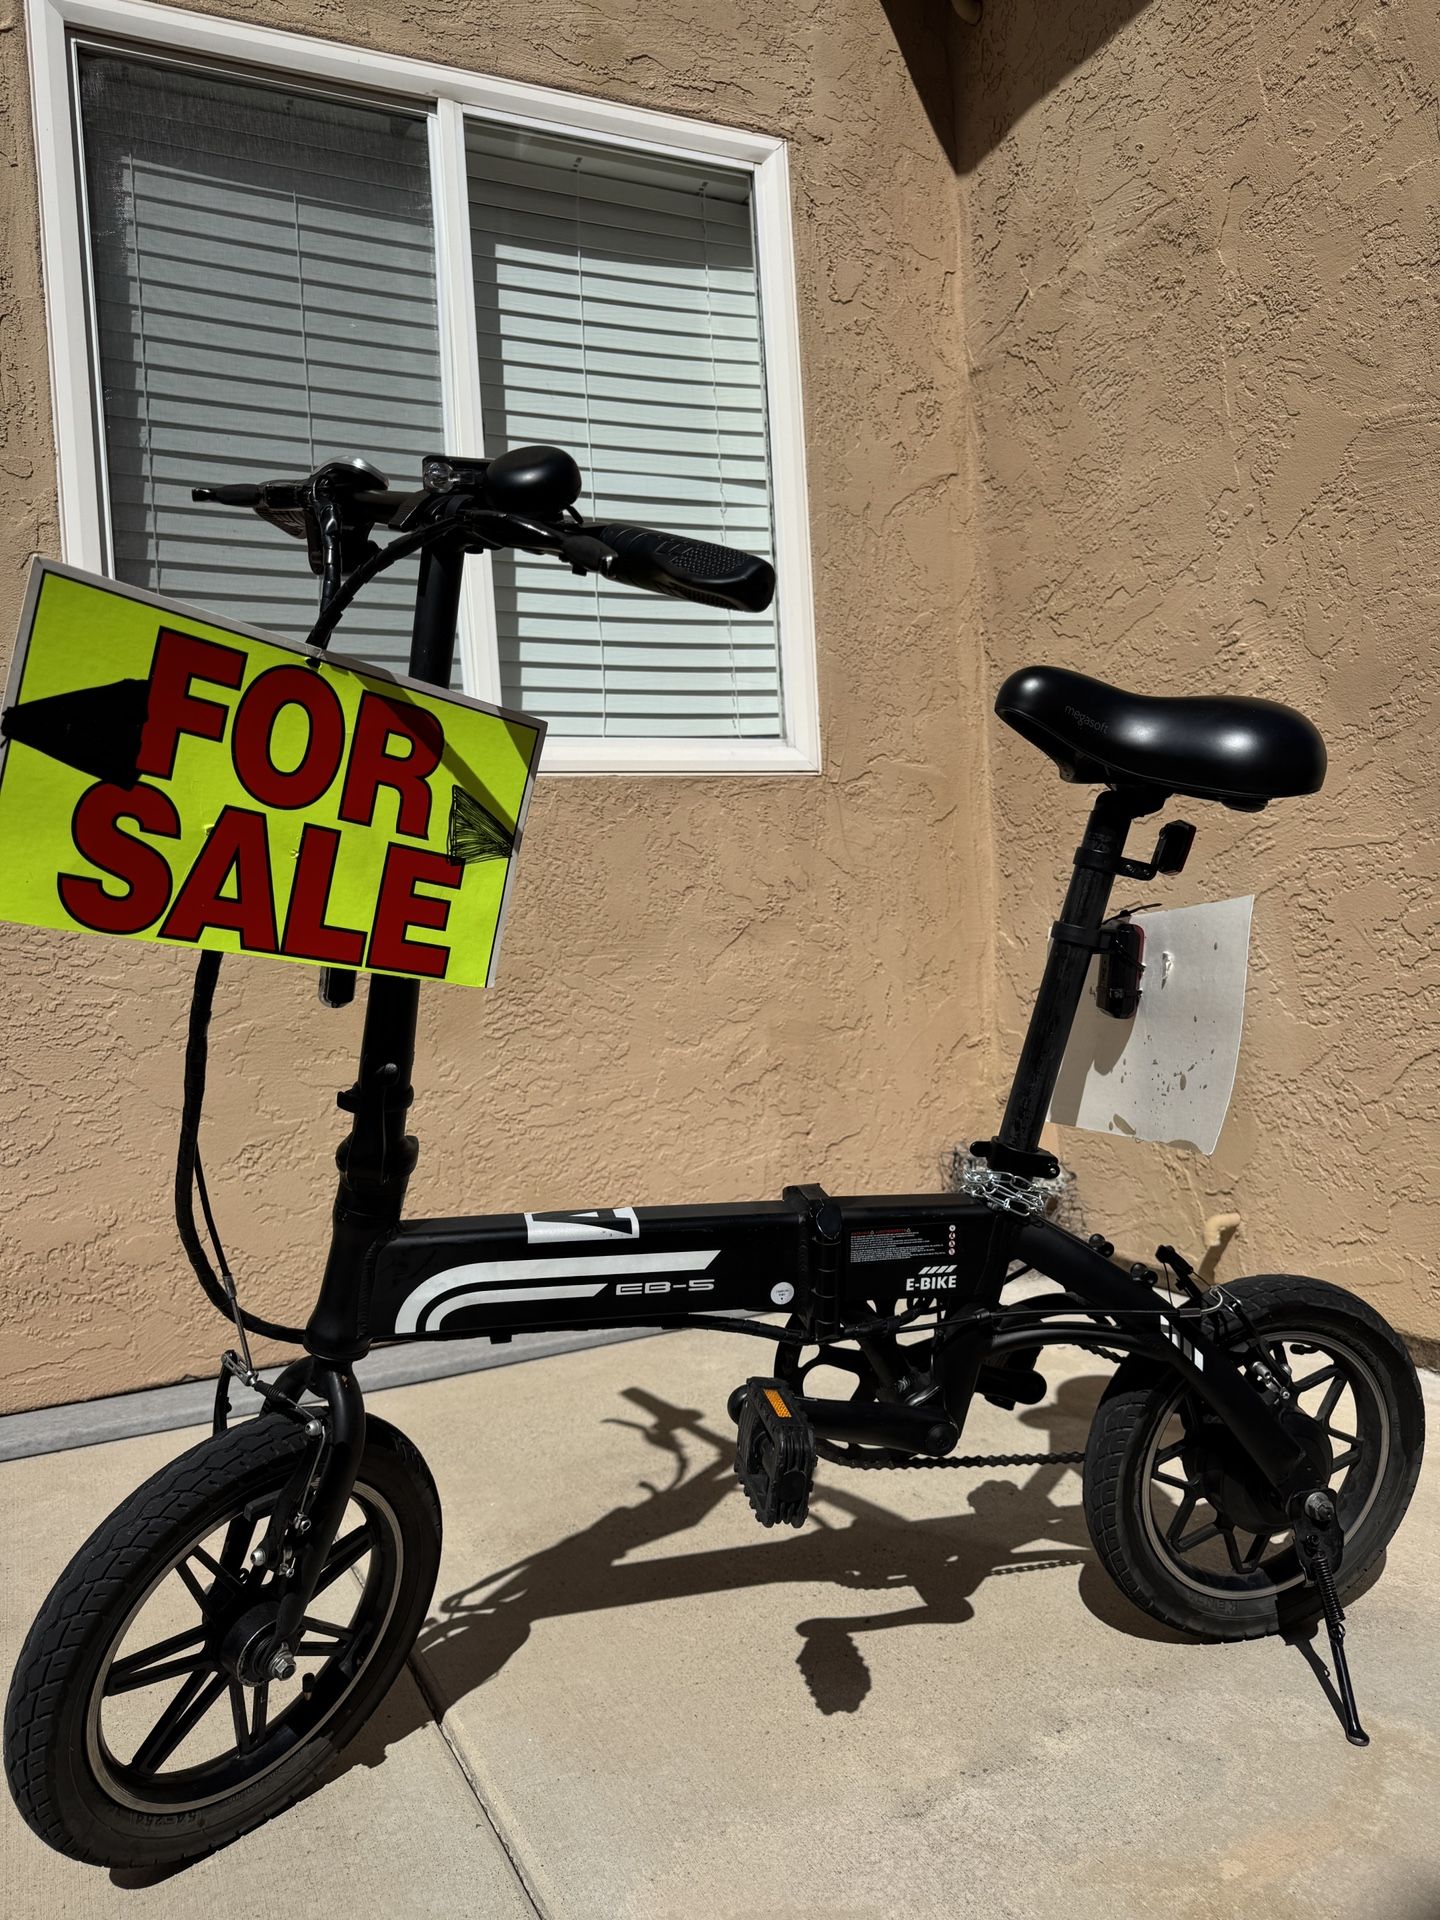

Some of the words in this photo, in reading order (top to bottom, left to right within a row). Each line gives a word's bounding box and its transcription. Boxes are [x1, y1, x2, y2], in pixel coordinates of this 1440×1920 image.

[134, 625, 445, 840] FOR
[1065, 705, 1109, 734] megasoft
[57, 778, 466, 979] SALE
[615, 1279, 715, 1296] EB-5
[906, 1275, 957, 1291] E-BIKE
